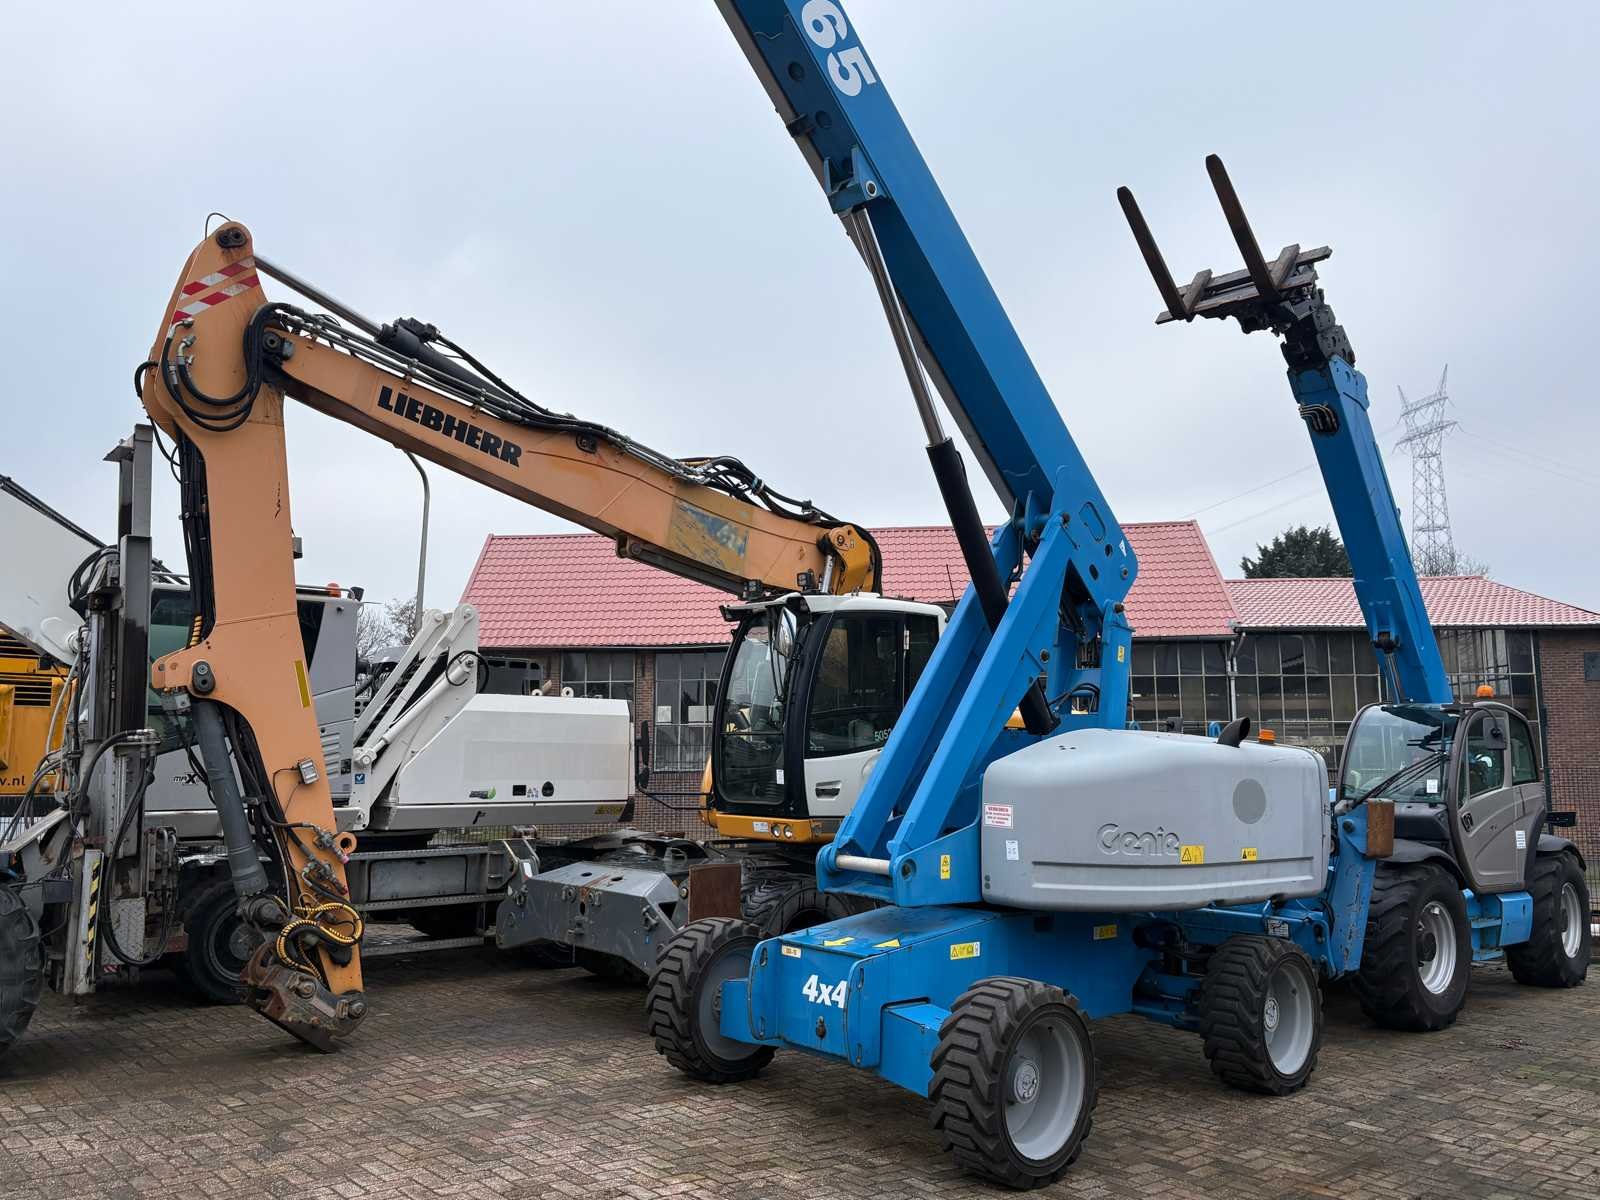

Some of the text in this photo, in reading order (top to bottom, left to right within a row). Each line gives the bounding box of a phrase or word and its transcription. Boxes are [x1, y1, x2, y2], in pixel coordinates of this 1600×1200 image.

[801, 0, 877, 97] 65
[377, 385, 523, 467] LIEBHERR
[1096, 822, 1181, 857] Genie
[802, 974, 848, 1009] 4x4
